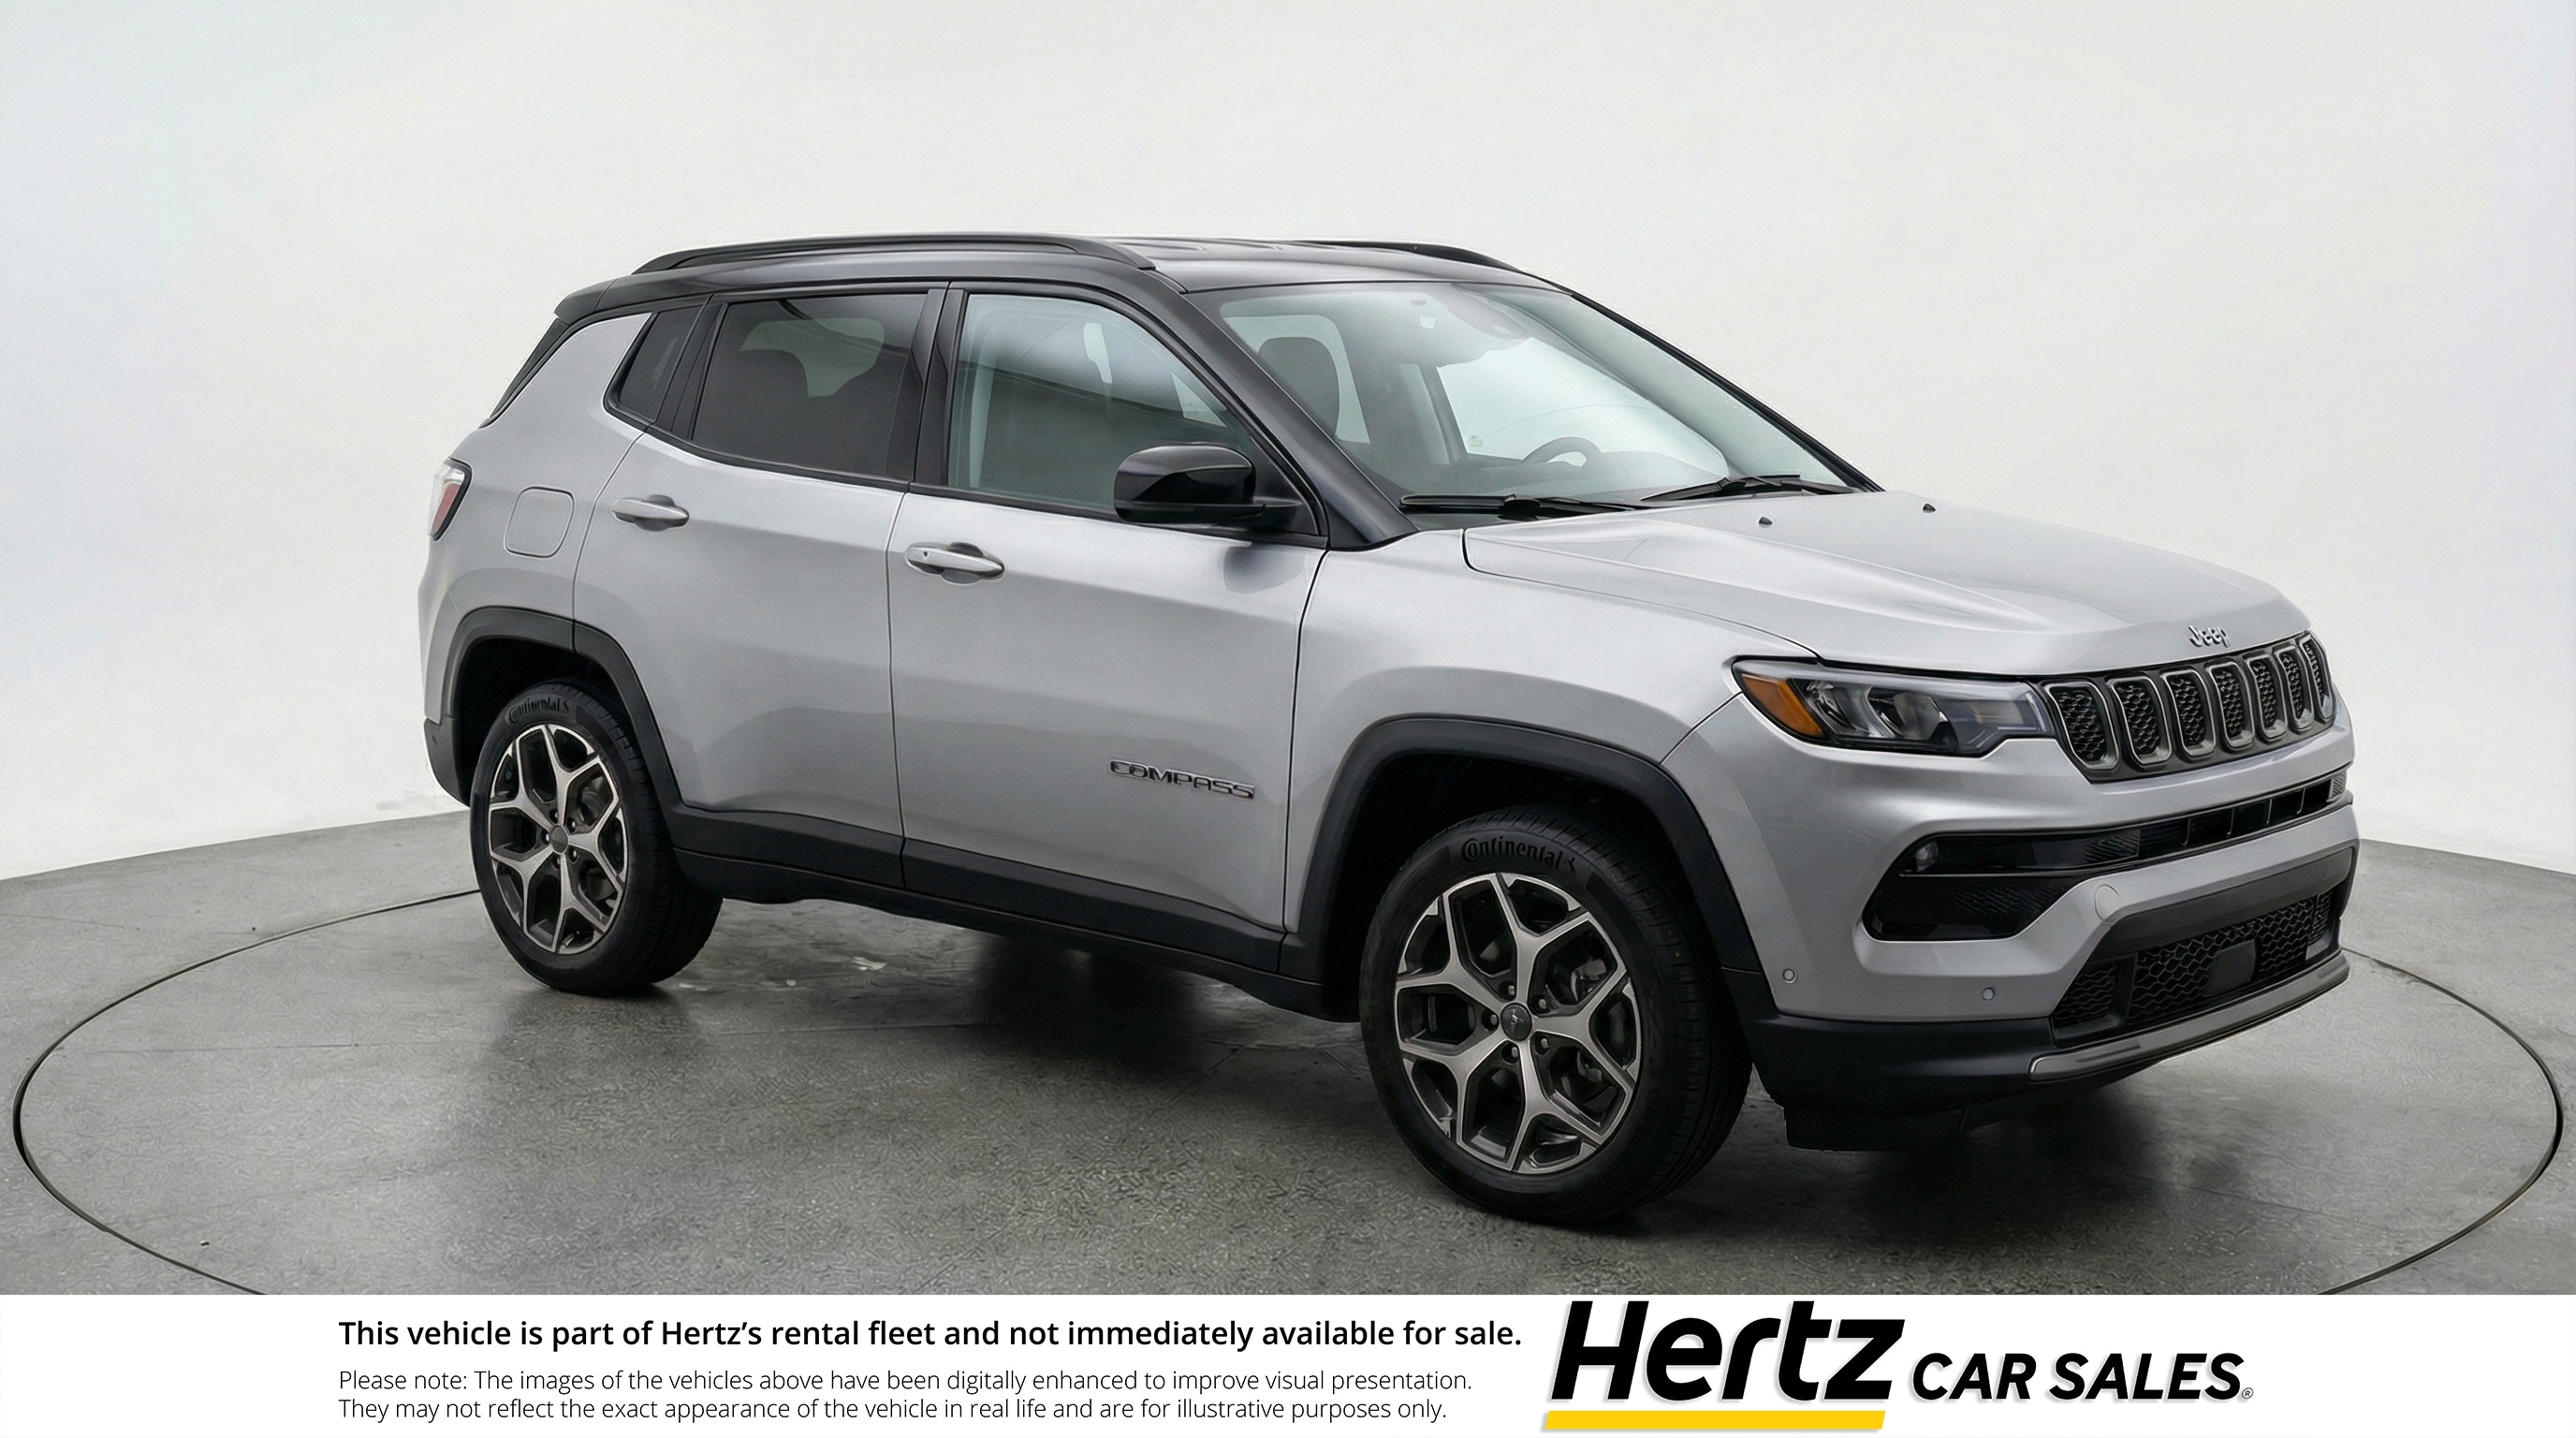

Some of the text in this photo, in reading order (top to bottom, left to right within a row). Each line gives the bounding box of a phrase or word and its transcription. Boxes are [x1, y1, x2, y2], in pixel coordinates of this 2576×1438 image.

[2188, 624, 2231, 648] Jeep
[1110, 758, 1256, 799] COMPASS
[1461, 835, 1564, 871] Continental
